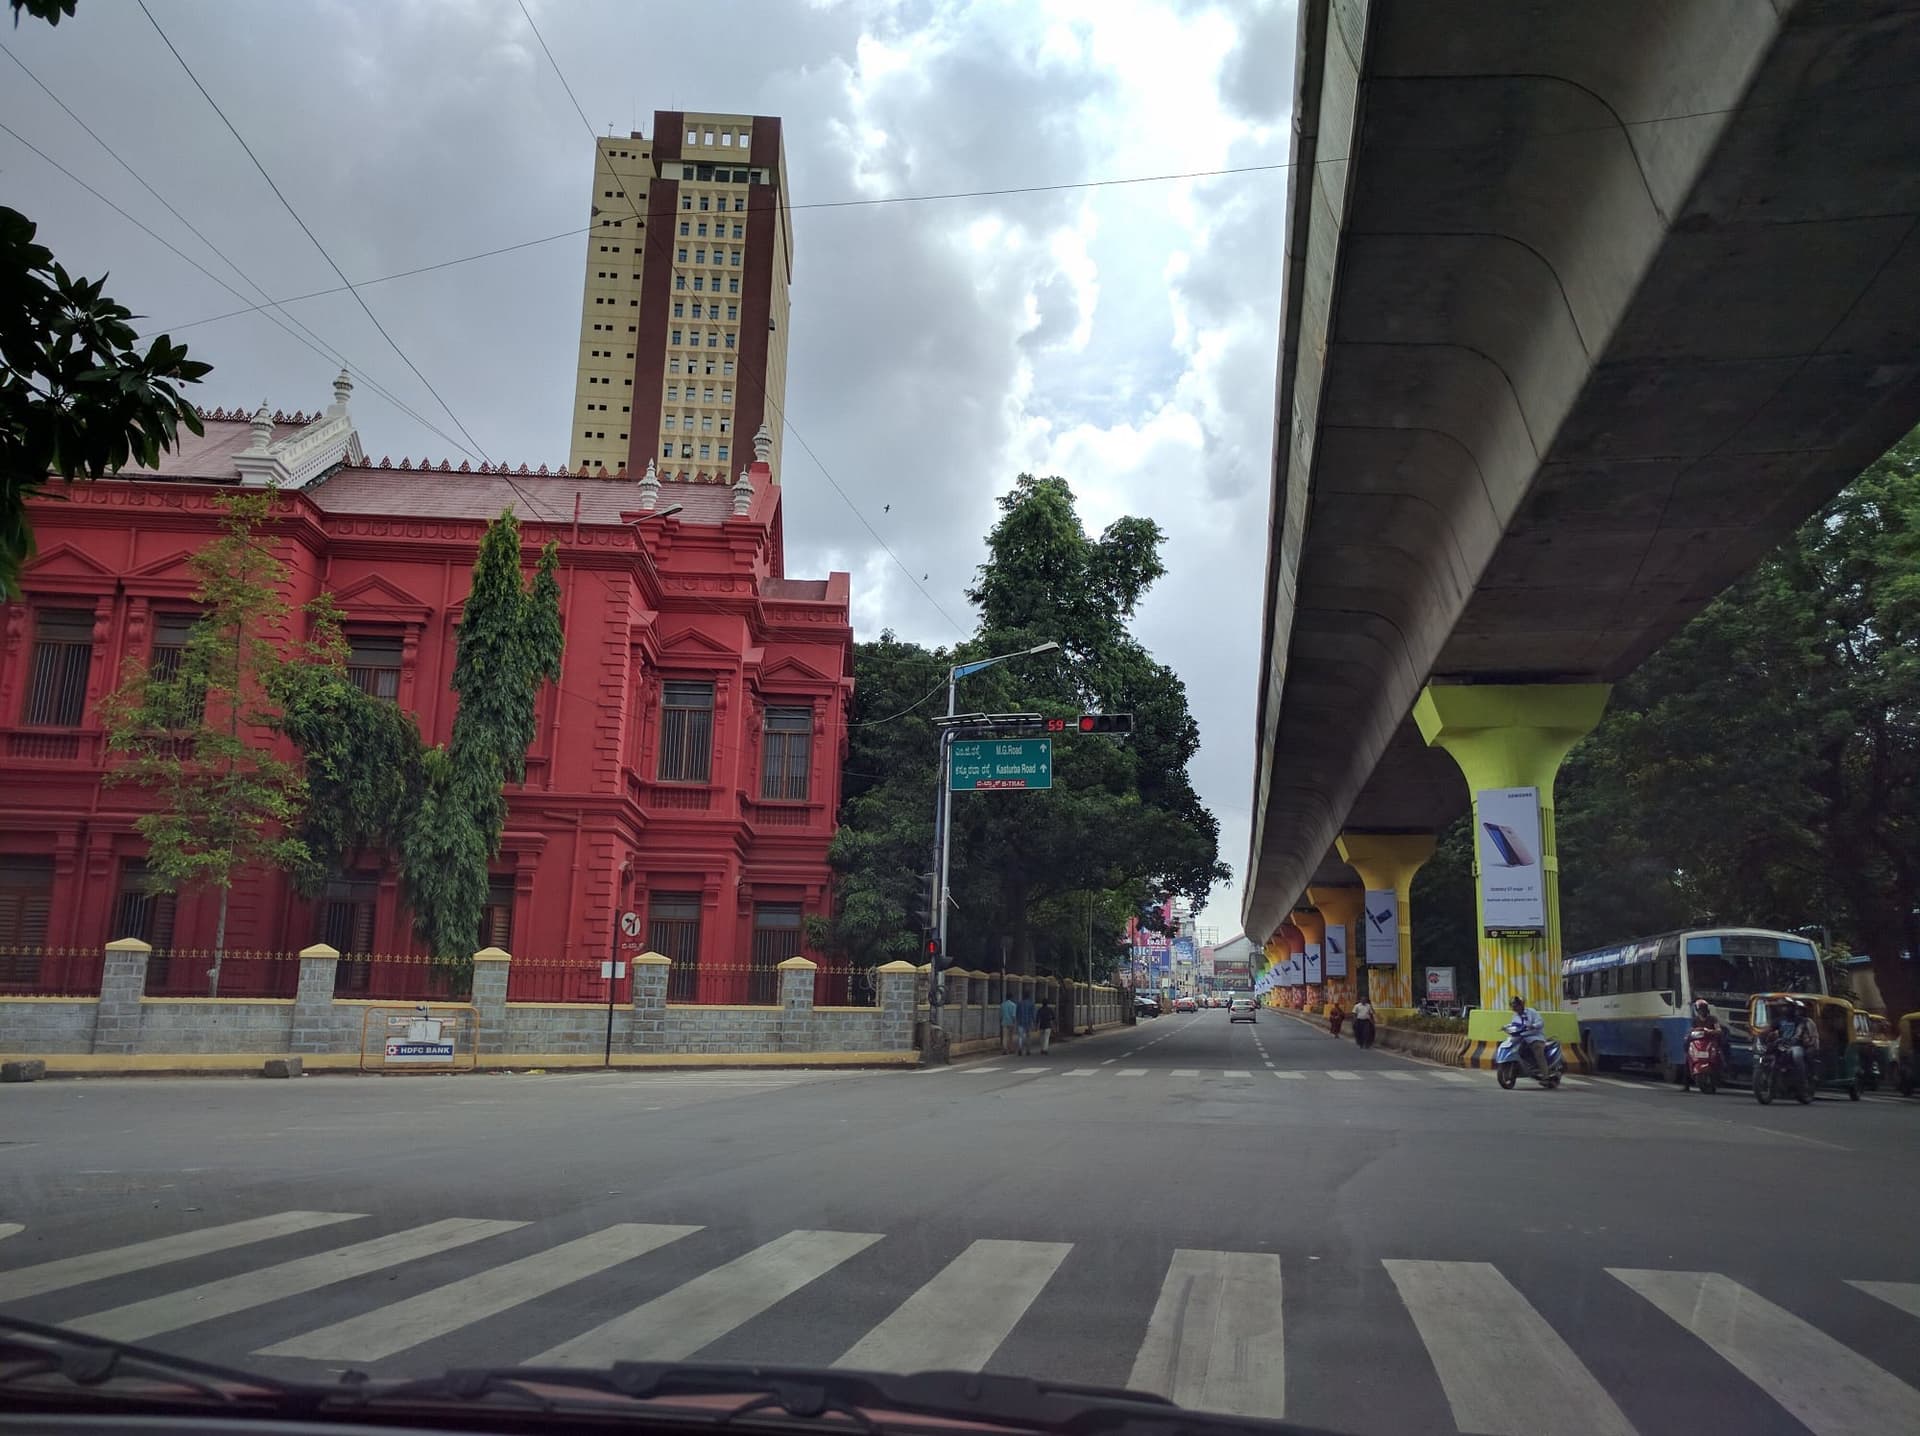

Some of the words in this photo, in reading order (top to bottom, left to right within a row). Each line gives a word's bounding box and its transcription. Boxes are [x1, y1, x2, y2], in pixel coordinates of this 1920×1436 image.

[1048, 719, 1064, 731] 59
[996, 764, 1020, 775] Kasturba
[1021, 763, 1036, 774] Road
[426, 1046, 450, 1054] BANK
